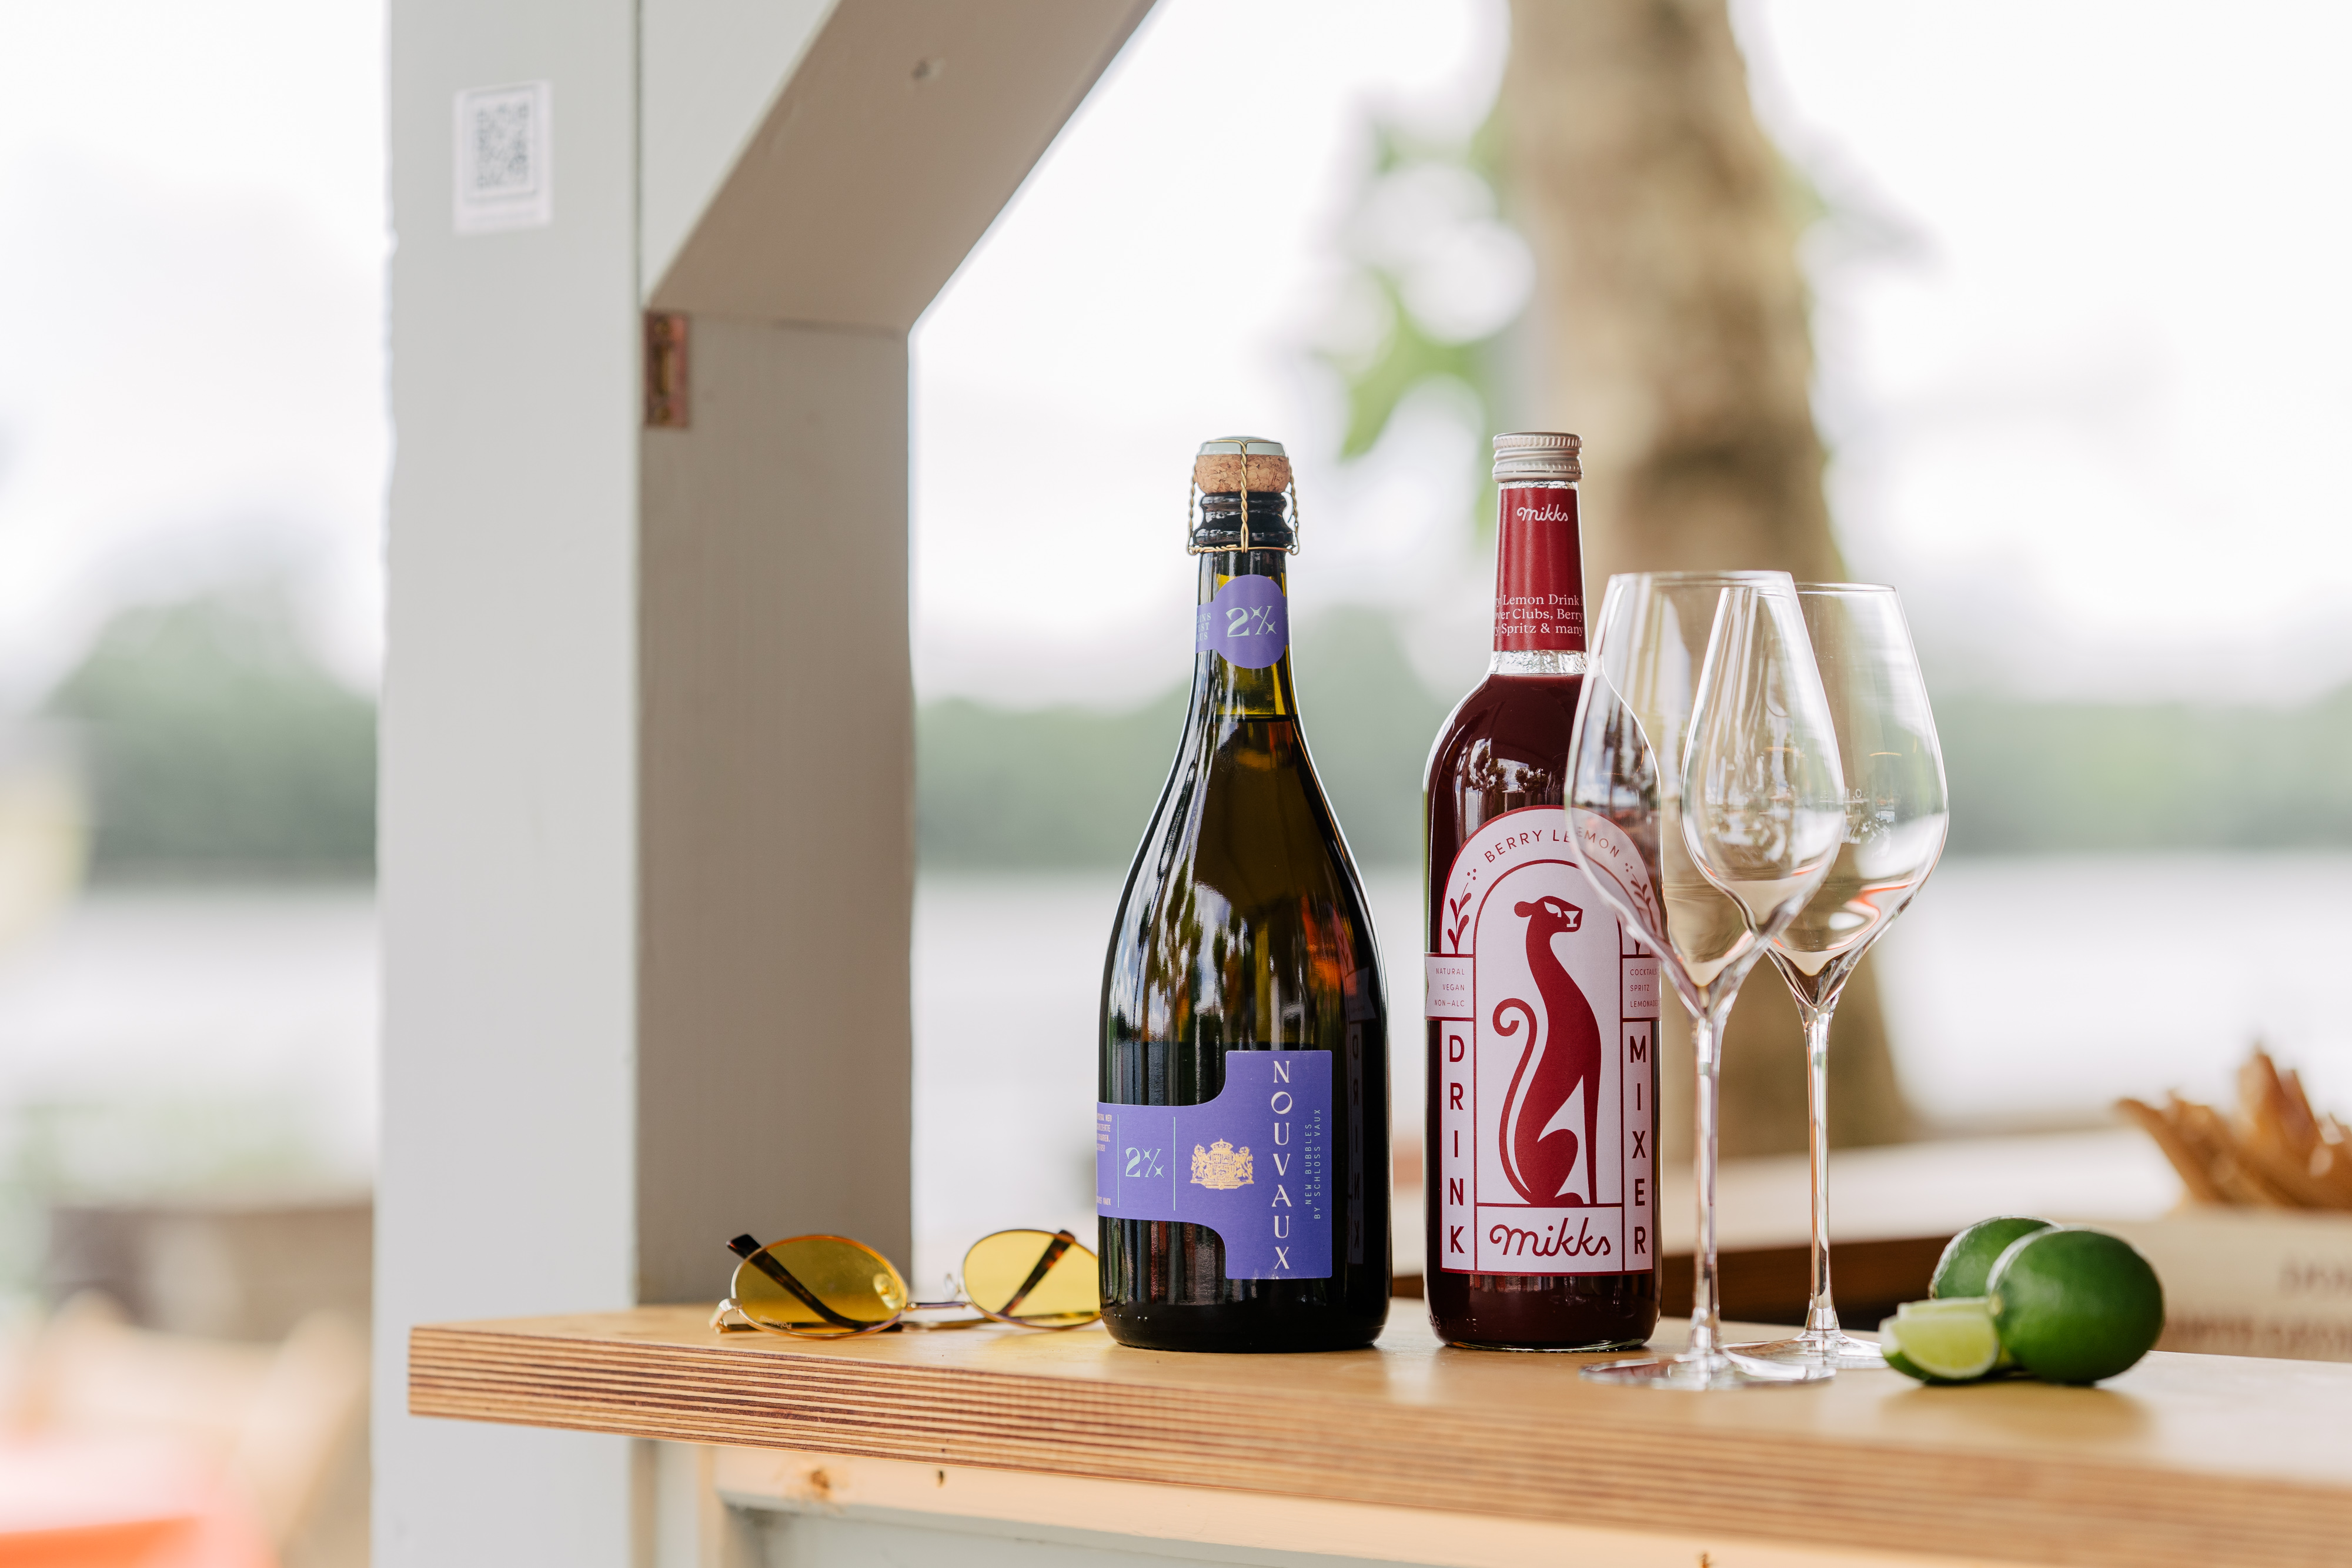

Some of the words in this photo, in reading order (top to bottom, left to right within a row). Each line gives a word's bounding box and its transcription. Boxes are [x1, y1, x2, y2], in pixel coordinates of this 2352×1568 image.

[1516, 504, 1569, 522] mikks
[1503, 594, 1545, 605] Lemon
[1548, 594, 1579, 606] Drink
[1512, 608, 1553, 621] Clubs,
[1556, 609, 1583, 622] Berry
[1501, 623, 1536, 637] Spritz
[1540, 623, 1551, 634] &
[1555, 626, 1583, 637] many
[1484, 830, 1542, 863] BERRY
[1434, 999, 1465, 1007] NON-ALC
[1449, 1034, 1465, 1255] DRINK
[1629, 1035, 1647, 1255] MIXER
[1271, 1060, 1293, 1270] NOUVAUX
[1314, 1206, 1321, 1219] BY
[1489, 1217, 1611, 1257] mikks
